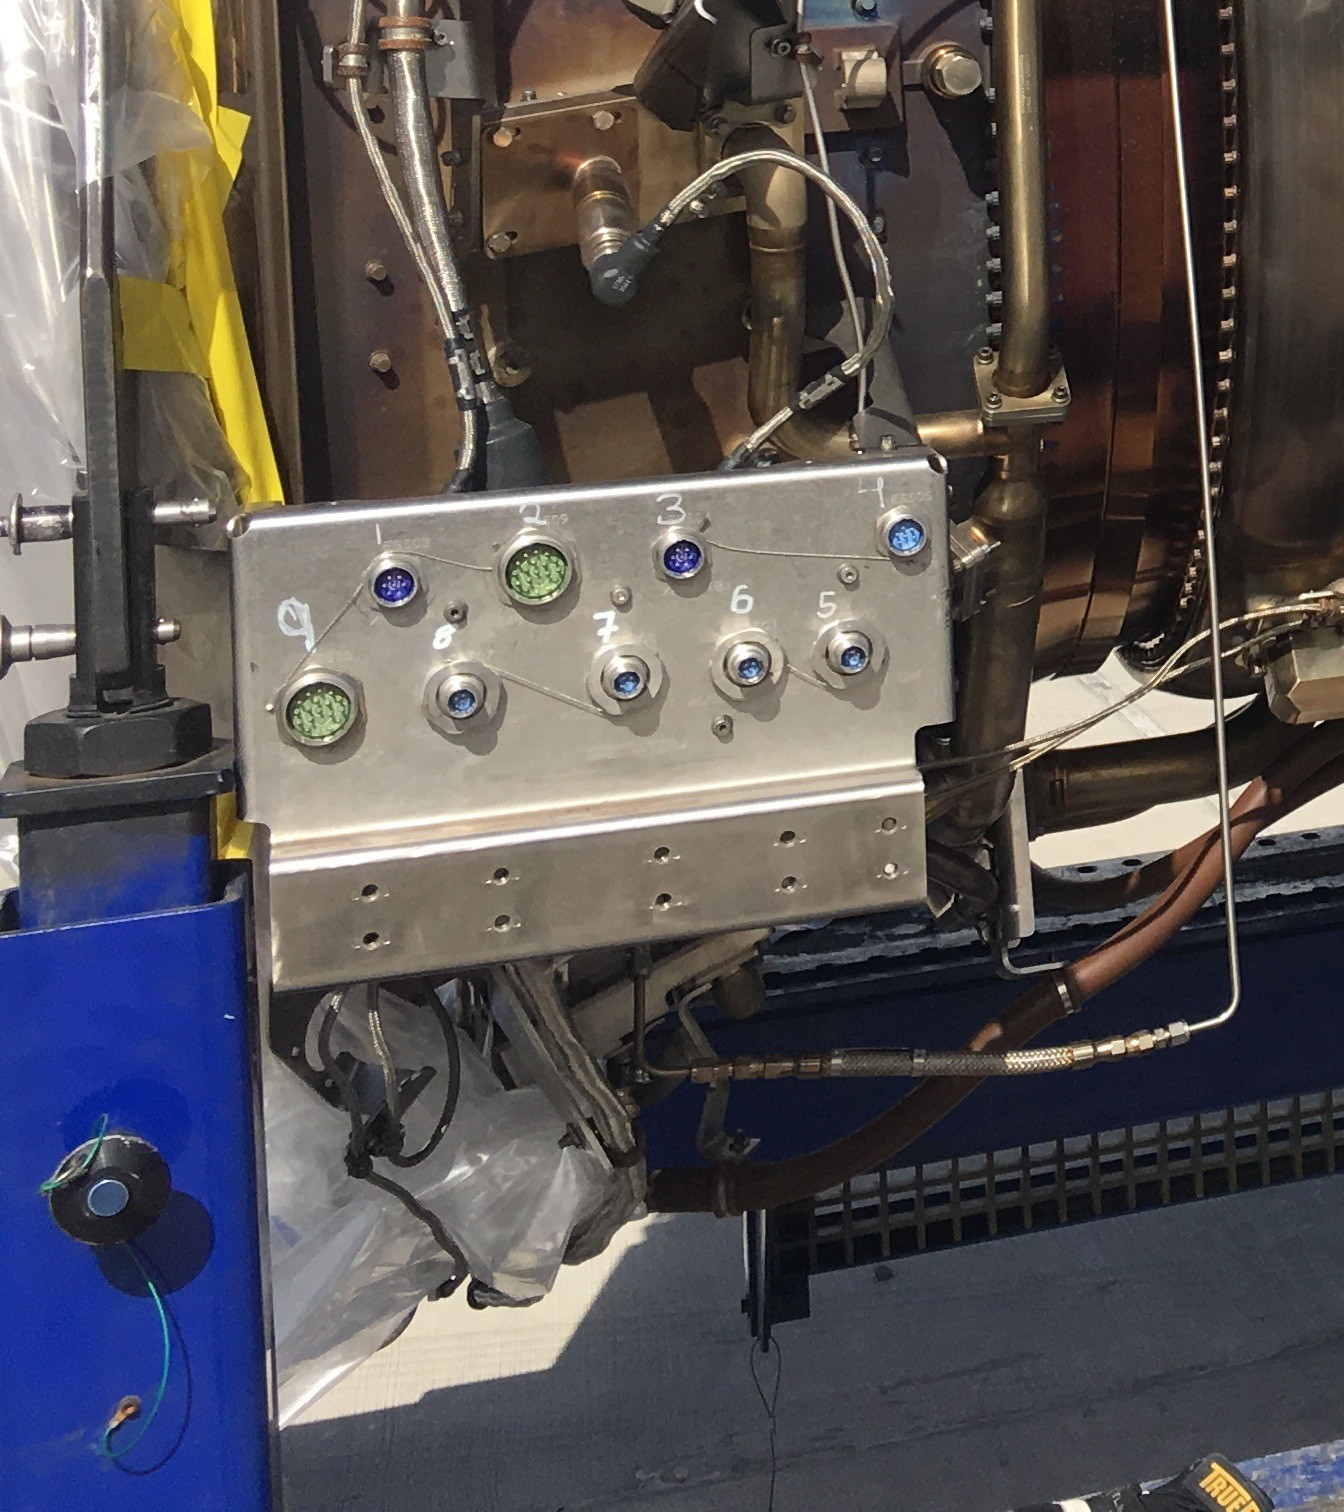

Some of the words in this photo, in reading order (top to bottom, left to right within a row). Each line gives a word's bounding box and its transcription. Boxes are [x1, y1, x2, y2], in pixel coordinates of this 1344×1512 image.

[858, 477, 885, 508] 4
[518, 503, 547, 525] 2
[656, 493, 686, 526] 3
[375, 523, 382, 545] 1
[730, 585, 754, 614] 6
[817, 591, 837, 619] 5
[277, 597, 316, 653] 9
[592, 611, 619, 644] 7
[1199, 1461, 1261, 1512] TRUE
